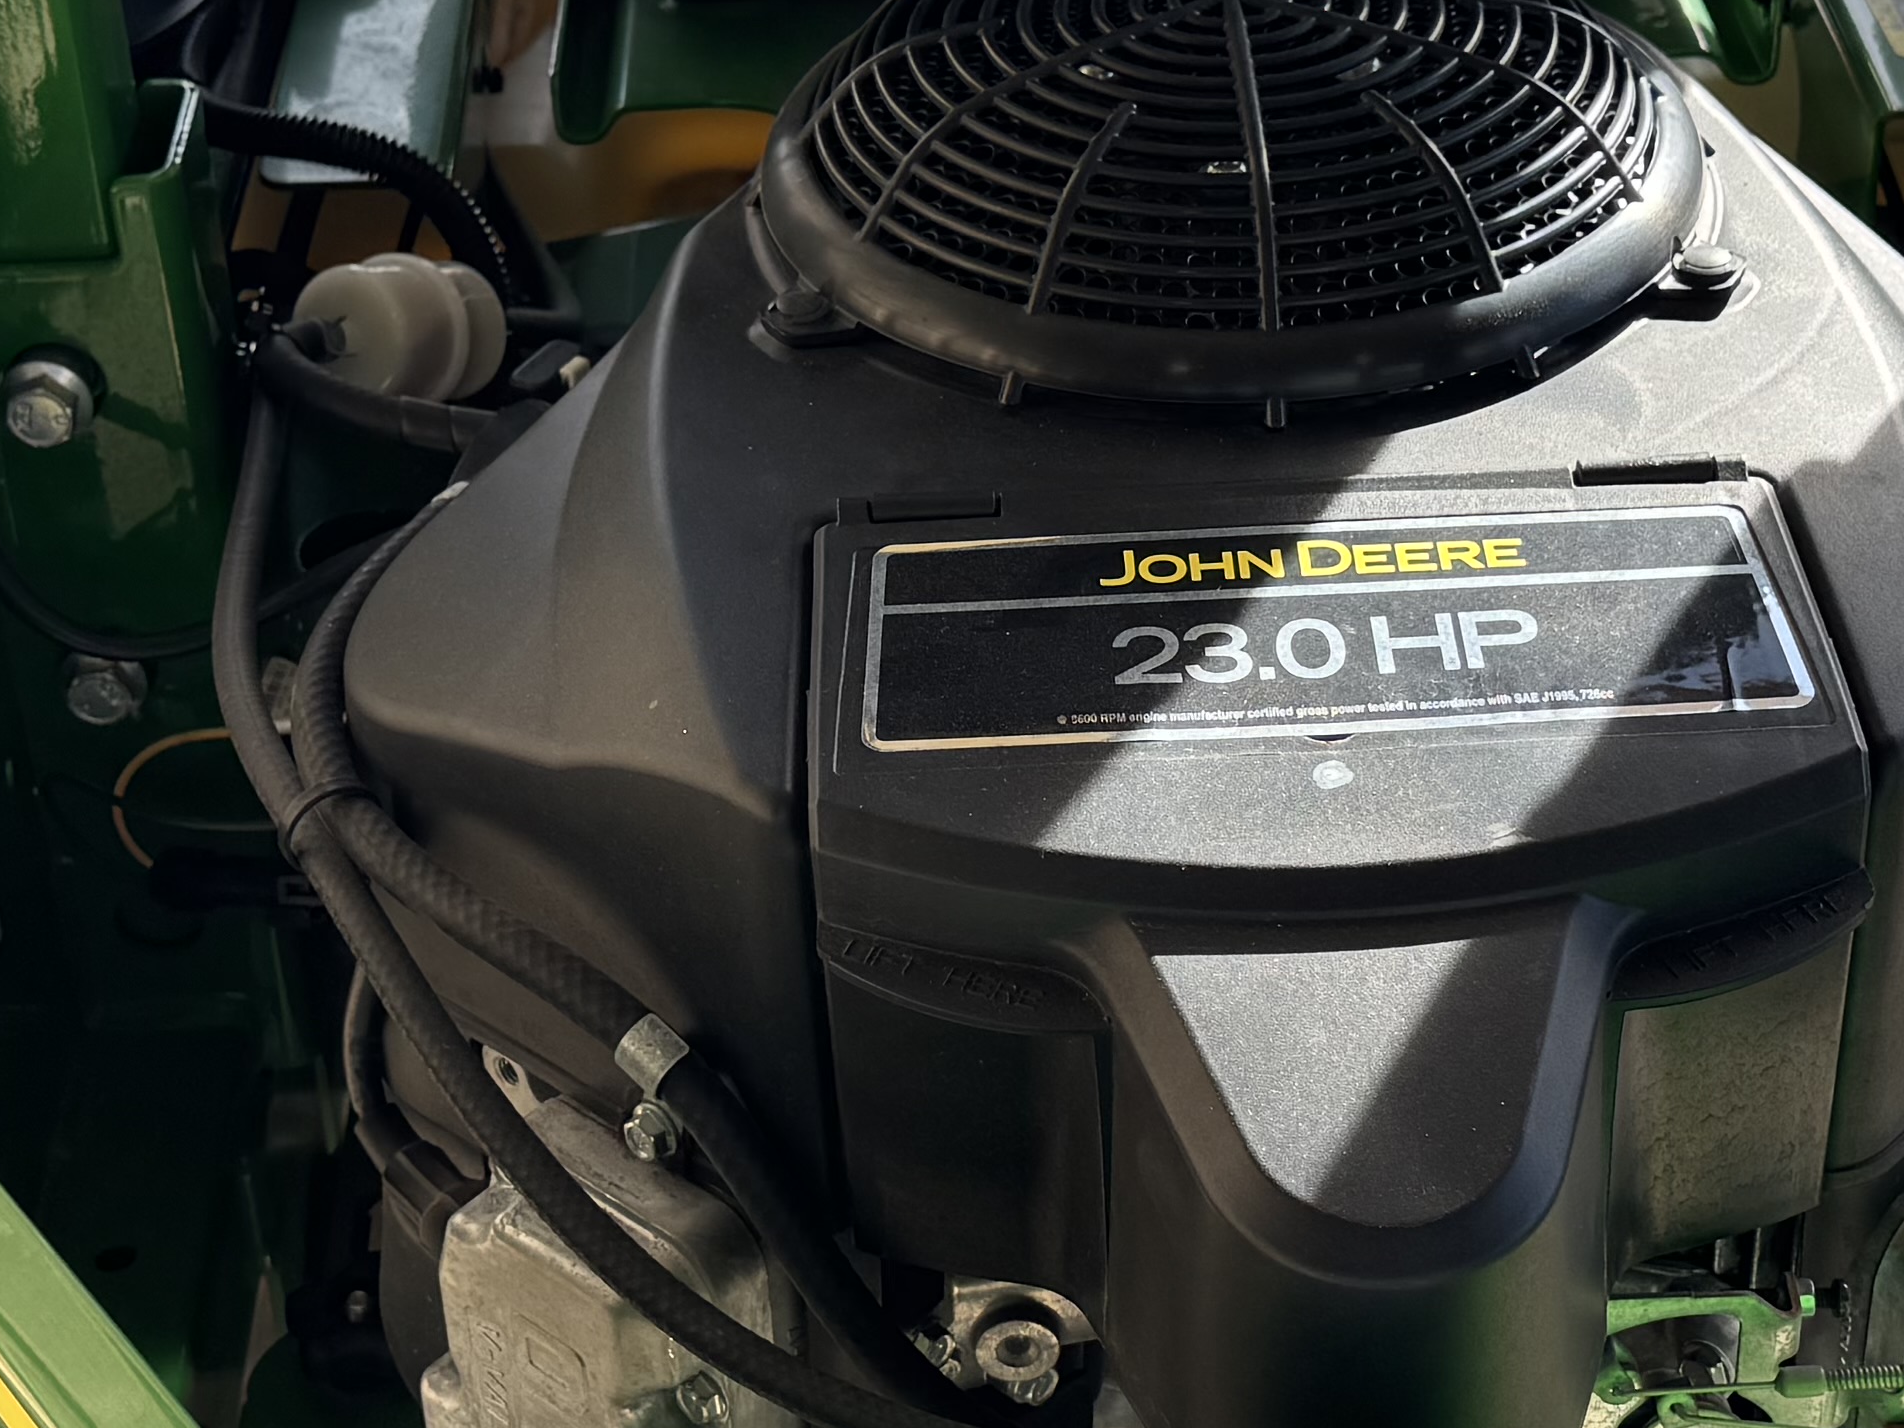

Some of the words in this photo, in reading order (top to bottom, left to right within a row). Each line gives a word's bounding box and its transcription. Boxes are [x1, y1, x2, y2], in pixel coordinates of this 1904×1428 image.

[1099, 548, 1284, 588] JOHN
[1297, 536, 1528, 577] DEERE
[1112, 617, 1347, 685] 23.0
[1370, 609, 1540, 676] HP
[1100, 712, 1127, 723] RPM
[1129, 710, 1168, 724] engine
[1170, 708, 1246, 722] manufacturer
[1247, 705, 1294, 719] certified
[1296, 706, 1329, 719] gross
[1330, 703, 1366, 717] power
[1367, 700, 1404, 713] tested
[1406, 699, 1417, 710] in
[1419, 696, 1486, 709] accordance
[1487, 693, 1512, 706] with
[1513, 691, 1540, 704] SAE
[842, 939, 913, 976] LIFT
